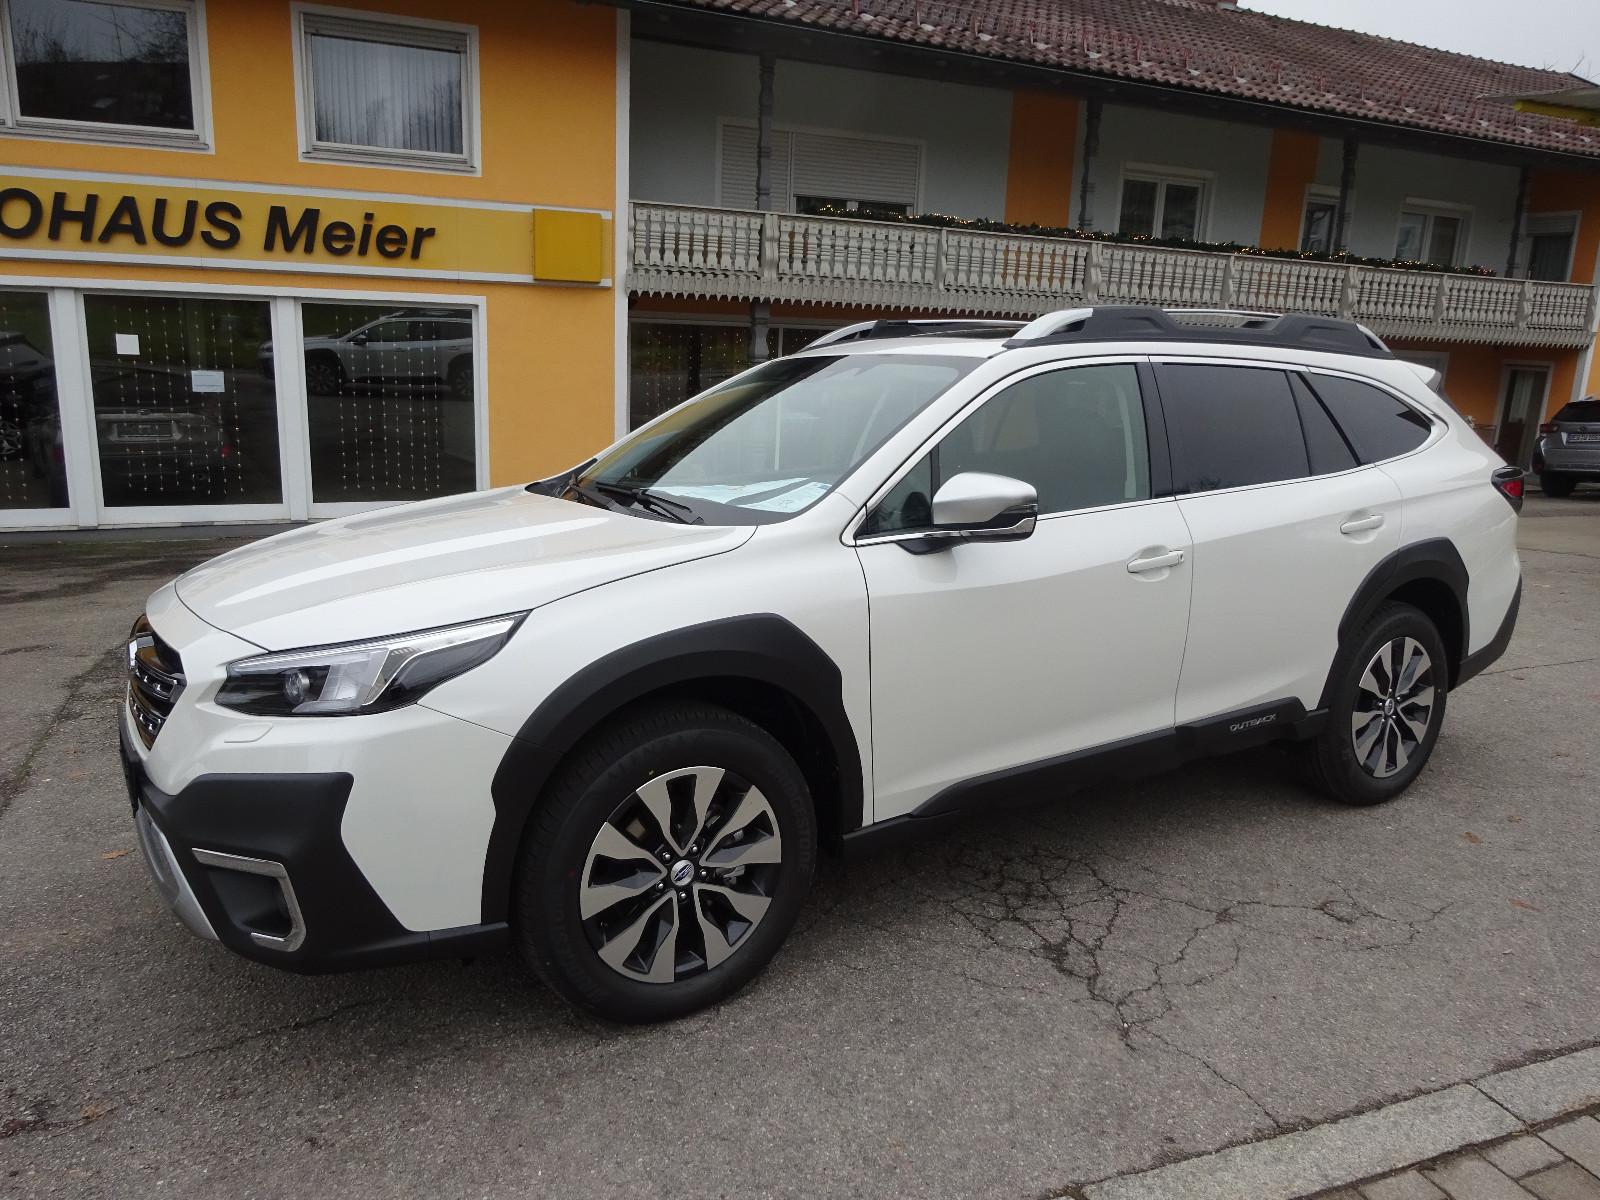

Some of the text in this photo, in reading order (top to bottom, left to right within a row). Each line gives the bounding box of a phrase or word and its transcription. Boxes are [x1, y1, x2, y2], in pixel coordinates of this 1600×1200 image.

[0, 188, 436, 259] OHAUS Meier
[1230, 713, 1276, 731] OUTBACK
